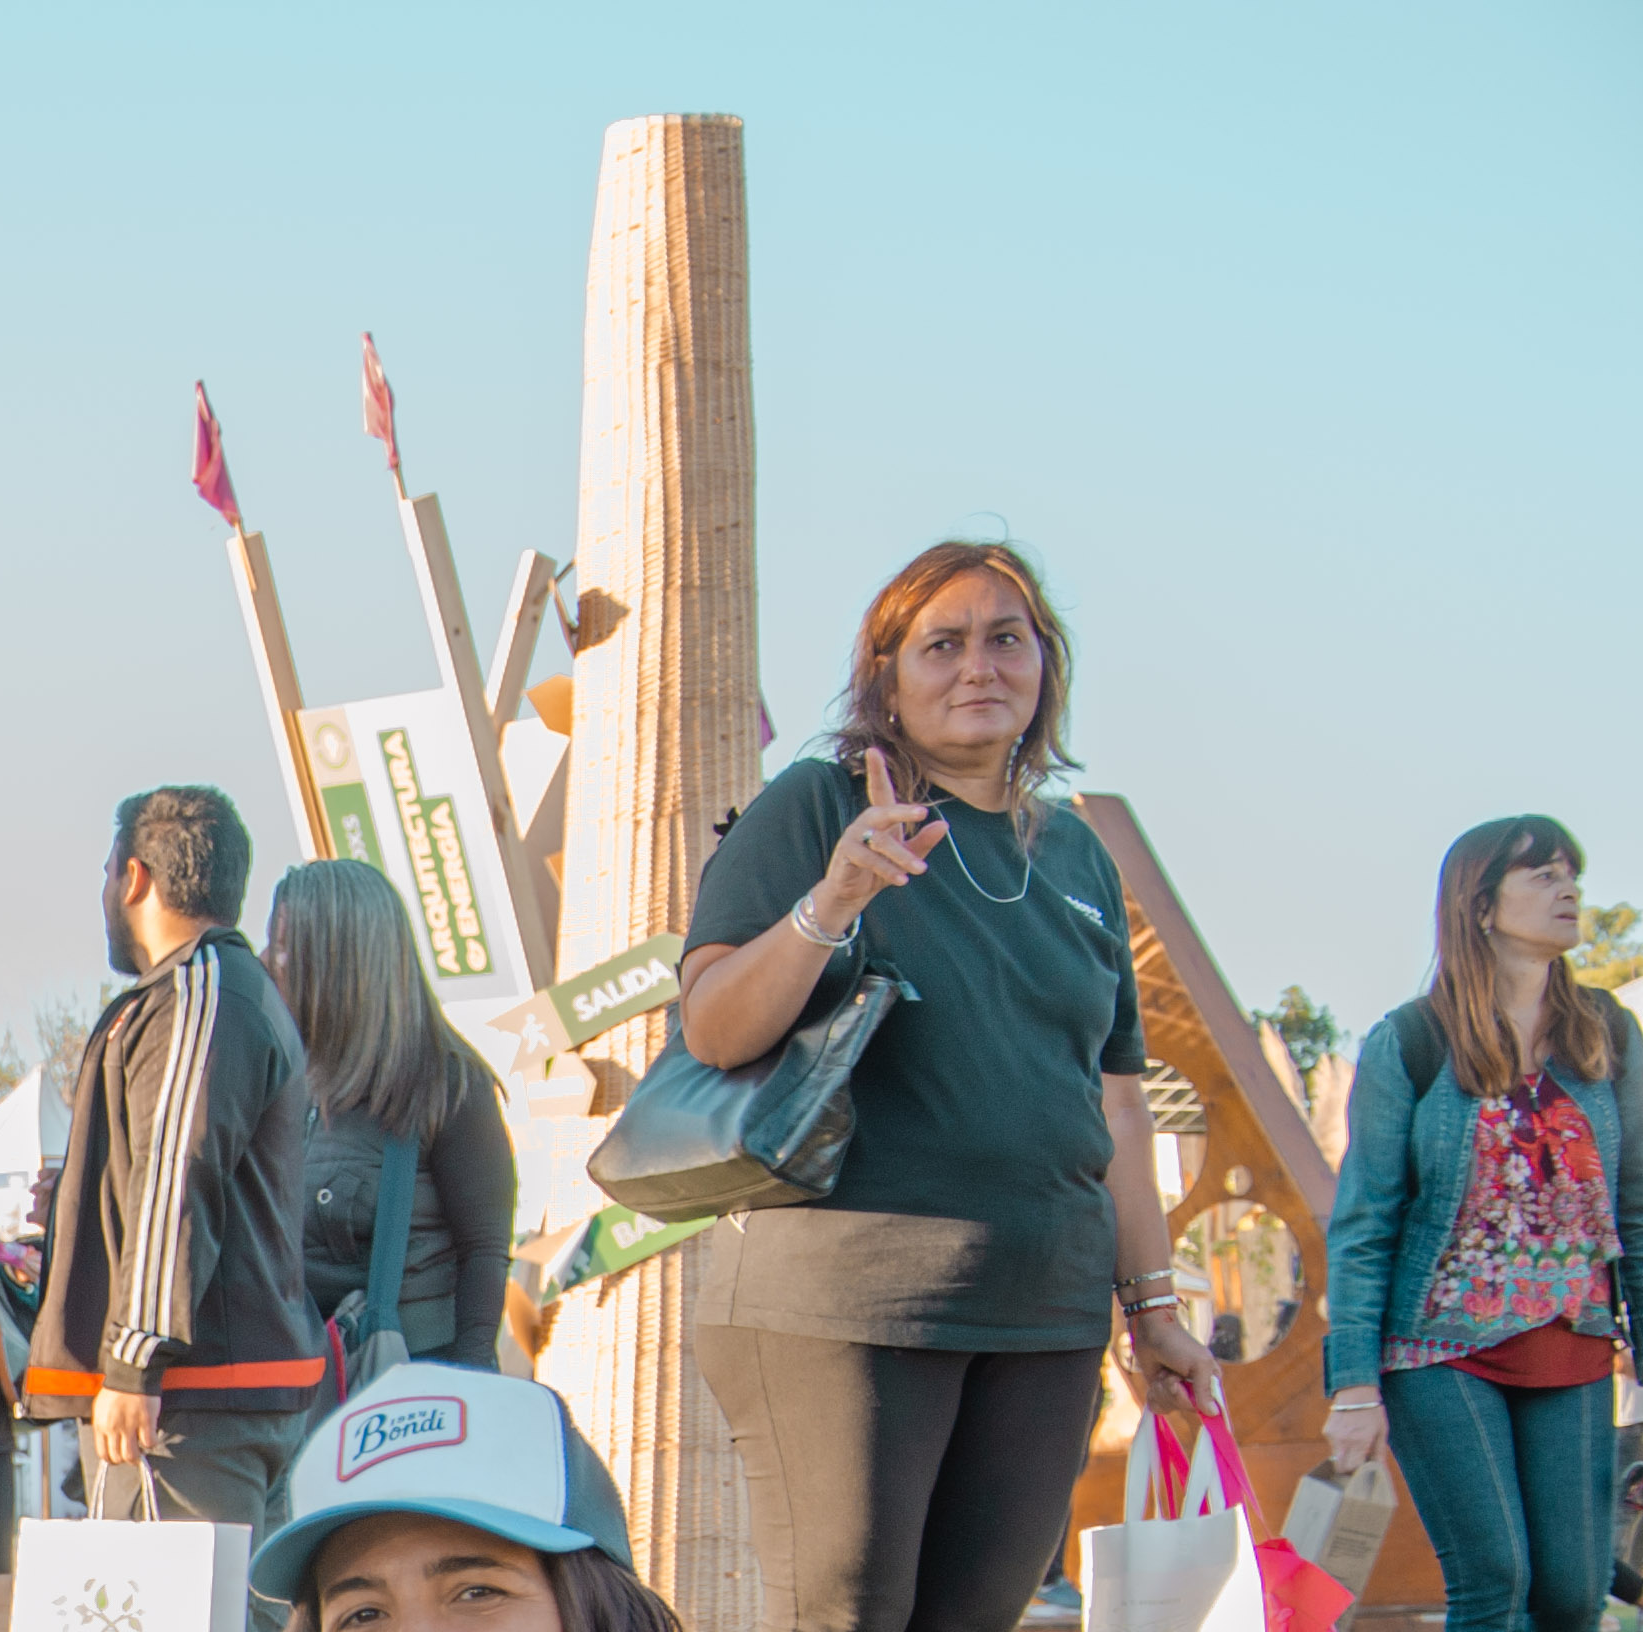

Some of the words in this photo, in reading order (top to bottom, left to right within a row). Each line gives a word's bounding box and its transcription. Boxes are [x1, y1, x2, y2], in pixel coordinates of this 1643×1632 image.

[384, 731, 461, 974] ARQUITECTURA
[430, 801, 481, 937] ENERGÍA
[572, 958, 674, 1023] SALIDA
[352, 1408, 446, 1461] Bondi
